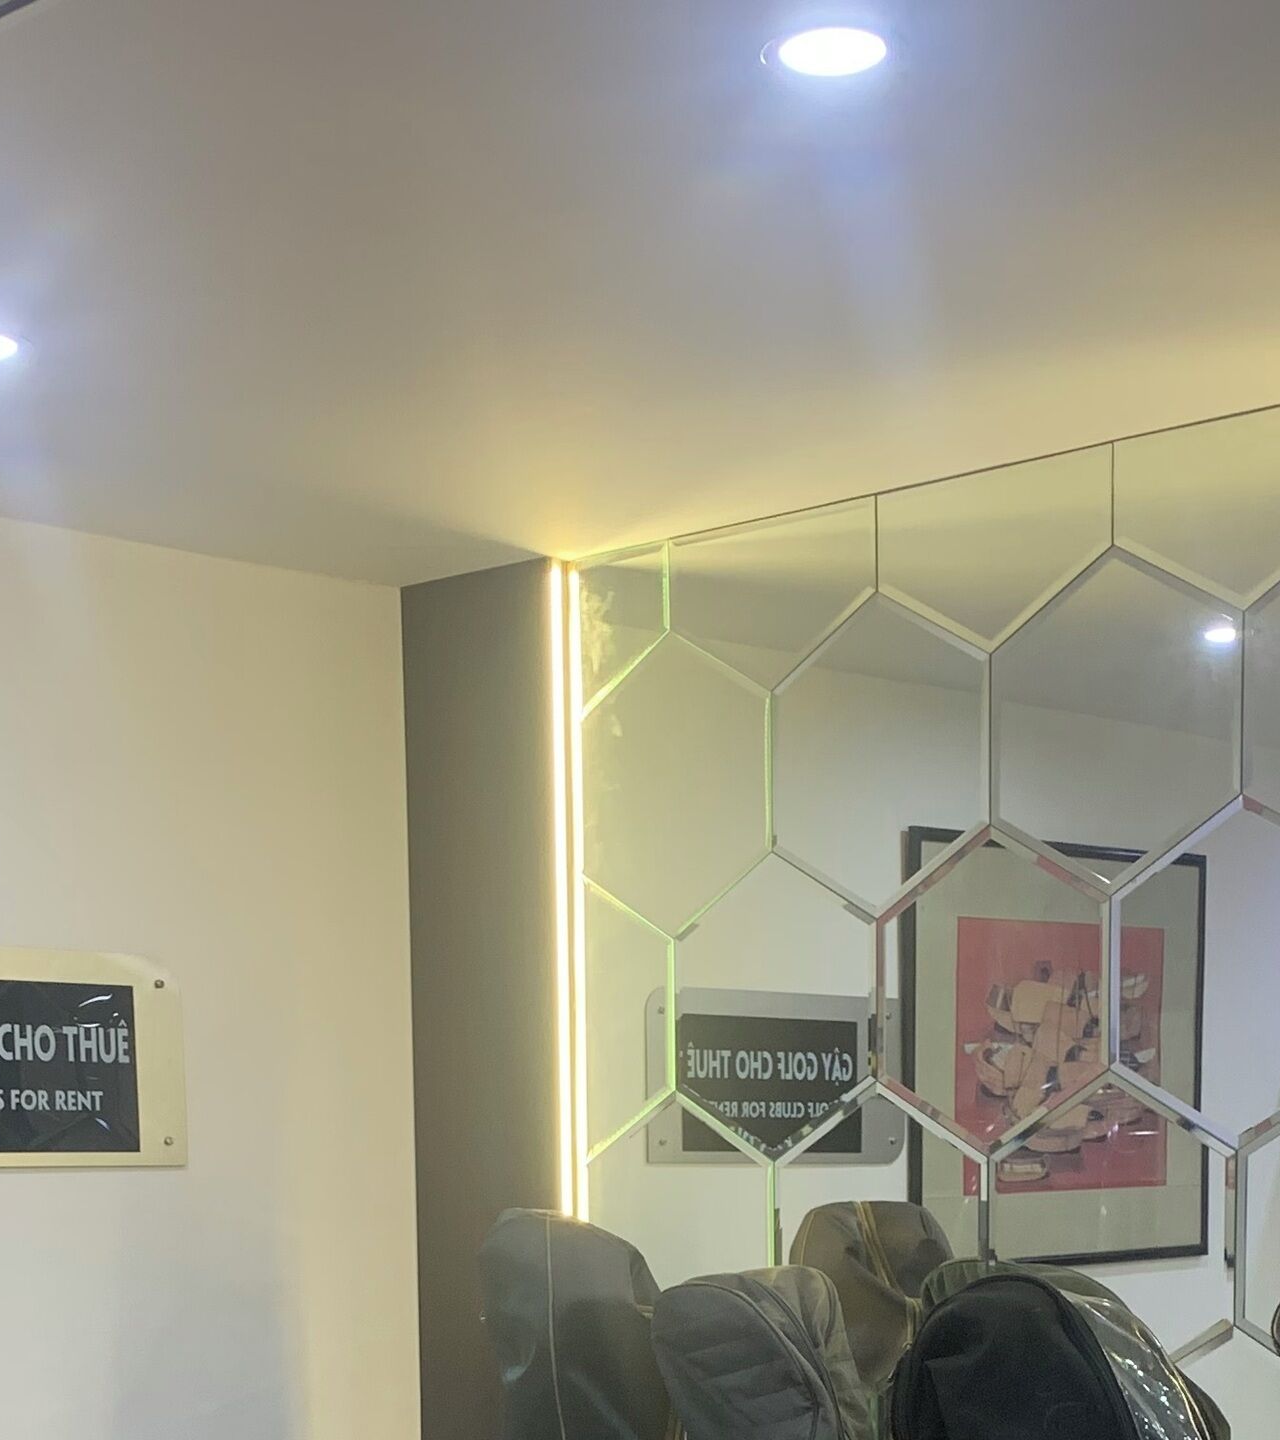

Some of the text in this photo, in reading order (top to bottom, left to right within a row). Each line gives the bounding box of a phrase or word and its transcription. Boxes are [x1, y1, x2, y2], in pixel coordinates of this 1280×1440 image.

[67, 1021, 130, 1064] THUÊ
[11, 1089, 49, 1111] FOR
[55, 1090, 103, 1111] RENT
